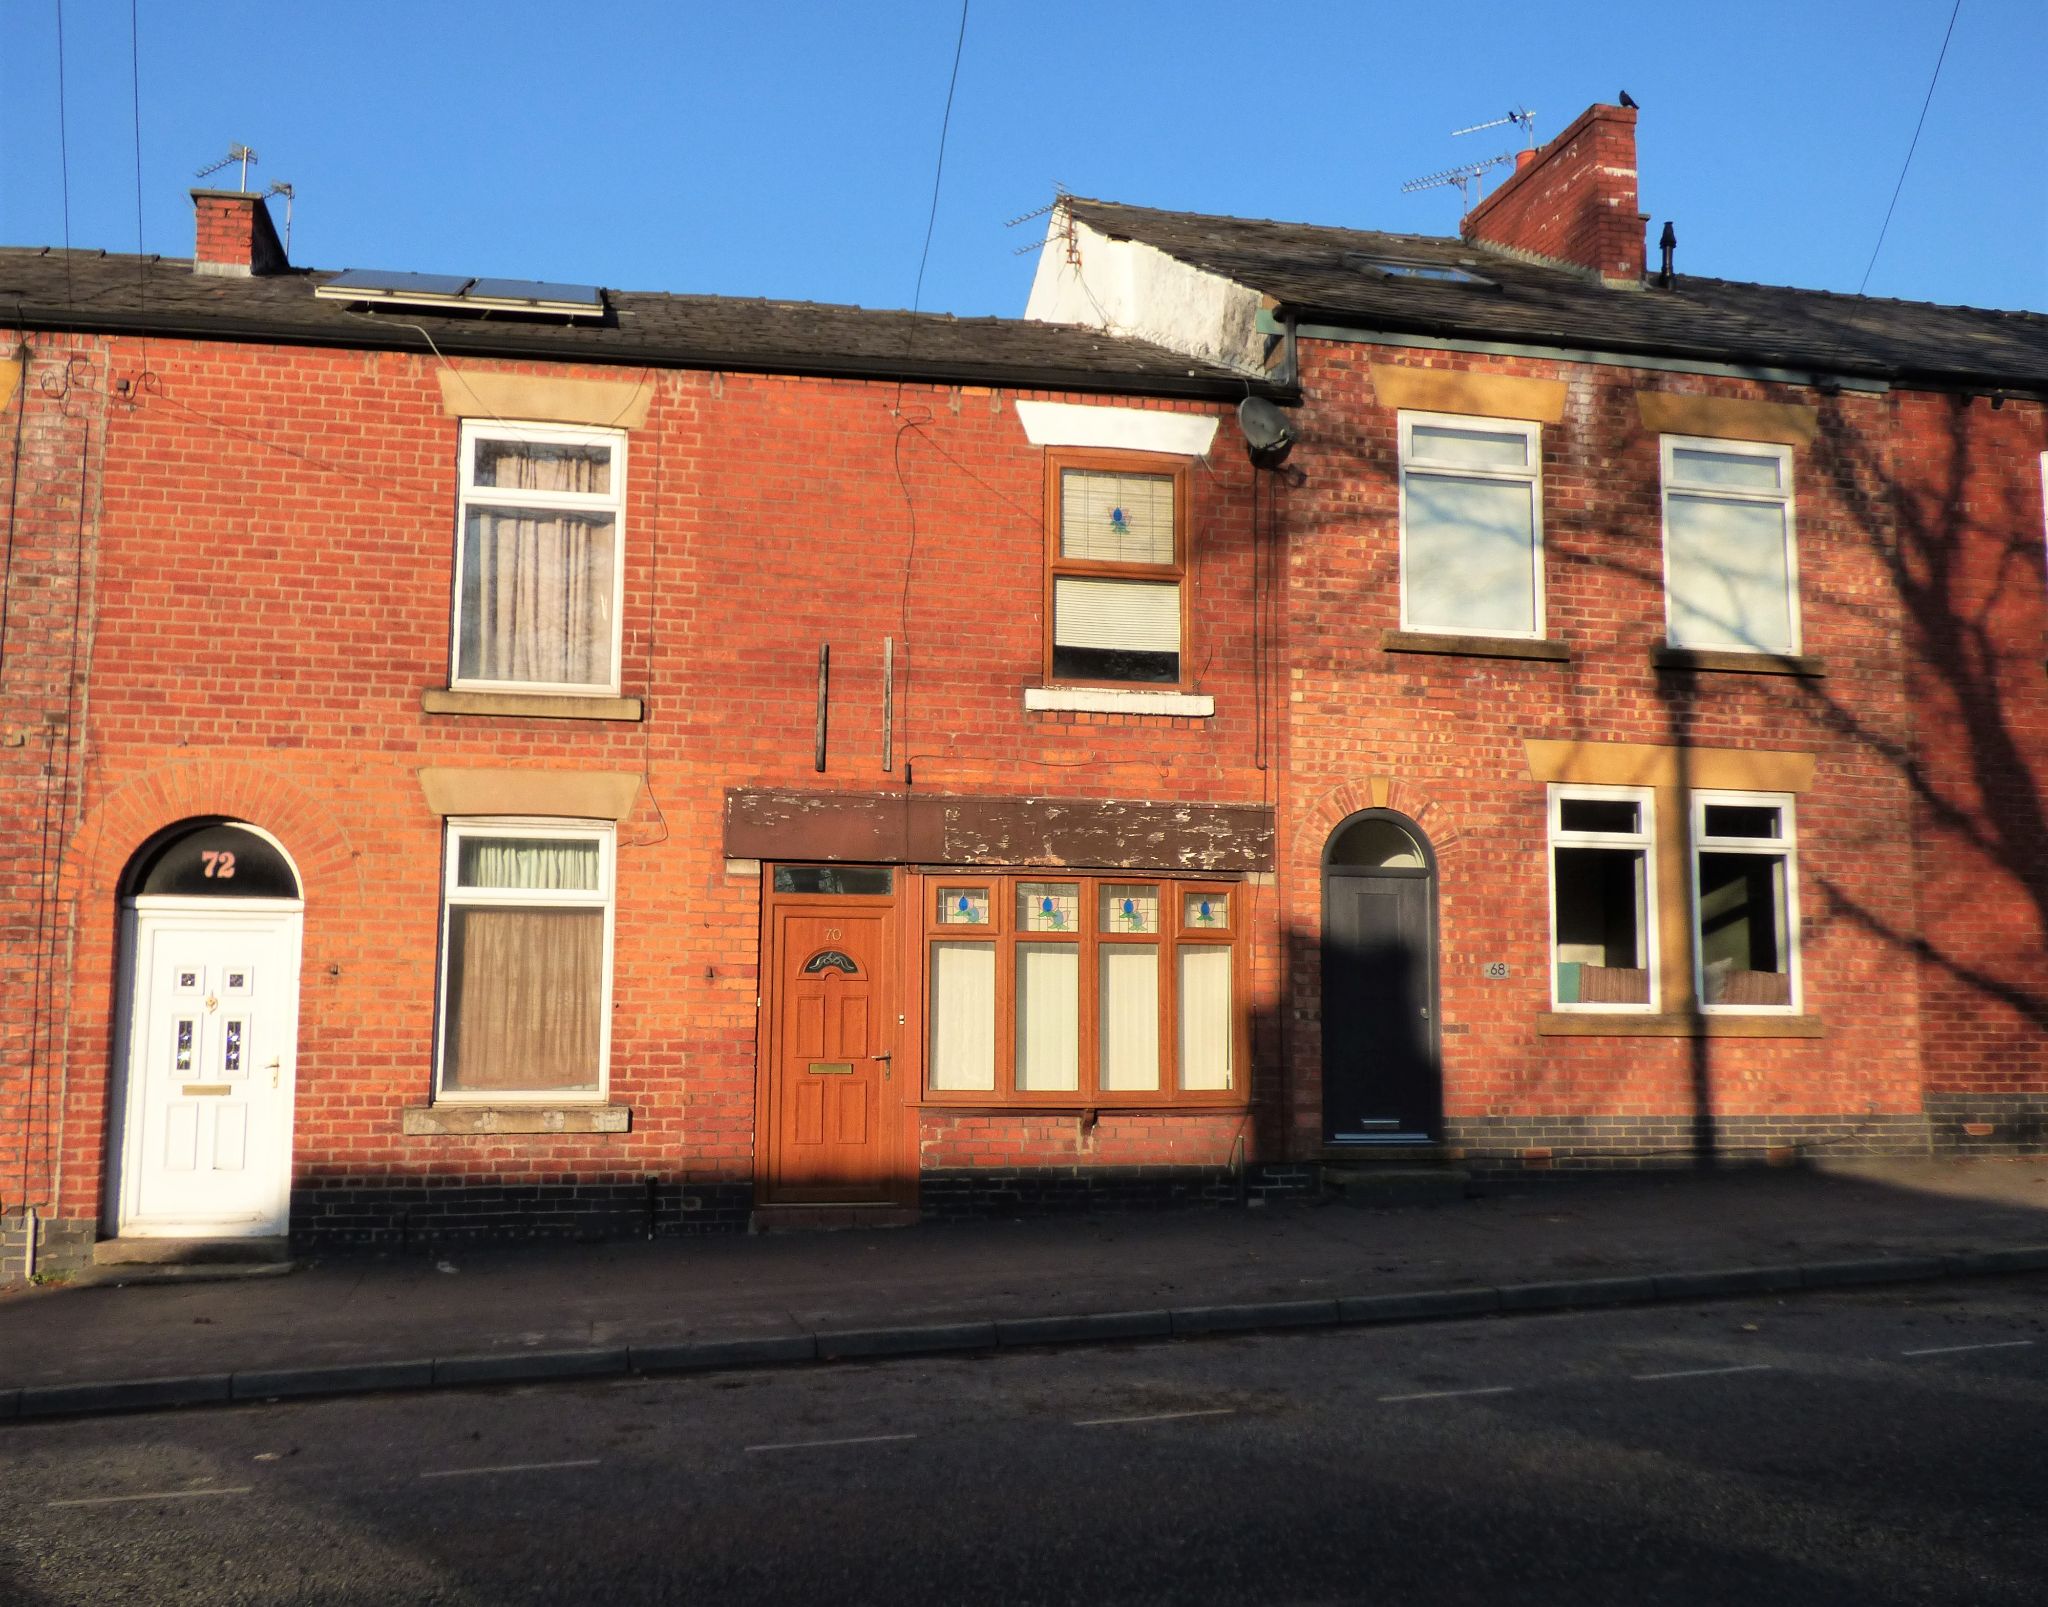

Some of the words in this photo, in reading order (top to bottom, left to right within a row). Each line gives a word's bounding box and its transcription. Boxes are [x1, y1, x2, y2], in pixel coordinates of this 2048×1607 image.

[202, 851, 235, 878] 72
[825, 928, 841, 940] 70
[1490, 963, 1505, 975] 68
